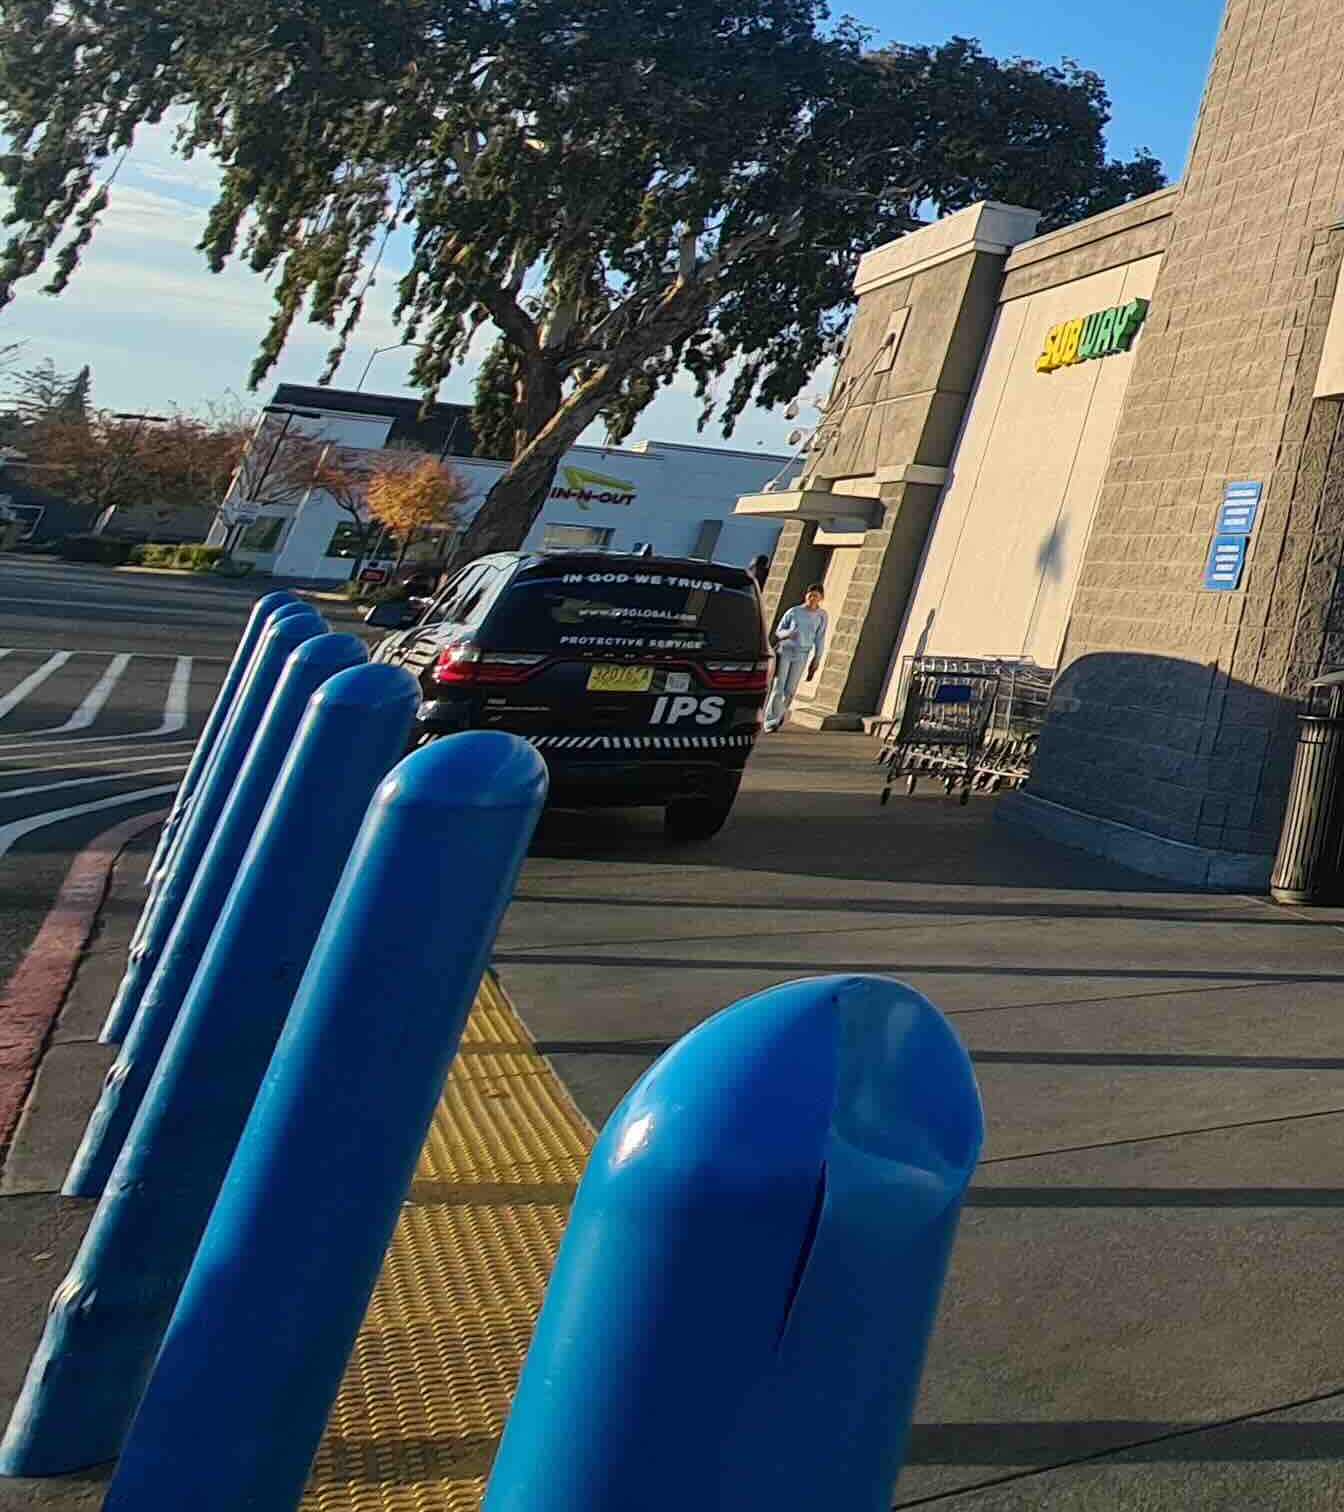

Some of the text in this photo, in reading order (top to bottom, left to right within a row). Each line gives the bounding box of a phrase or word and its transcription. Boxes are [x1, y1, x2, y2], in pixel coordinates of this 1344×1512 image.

[1036, 296, 1149, 374] SUBWAY
[550, 487, 637, 506] IN-N-OUT
[562, 573, 724, 592] IN GOD WE TRUST
[559, 636, 645, 647] PROTECTIVE
[648, 695, 726, 725] IPS
